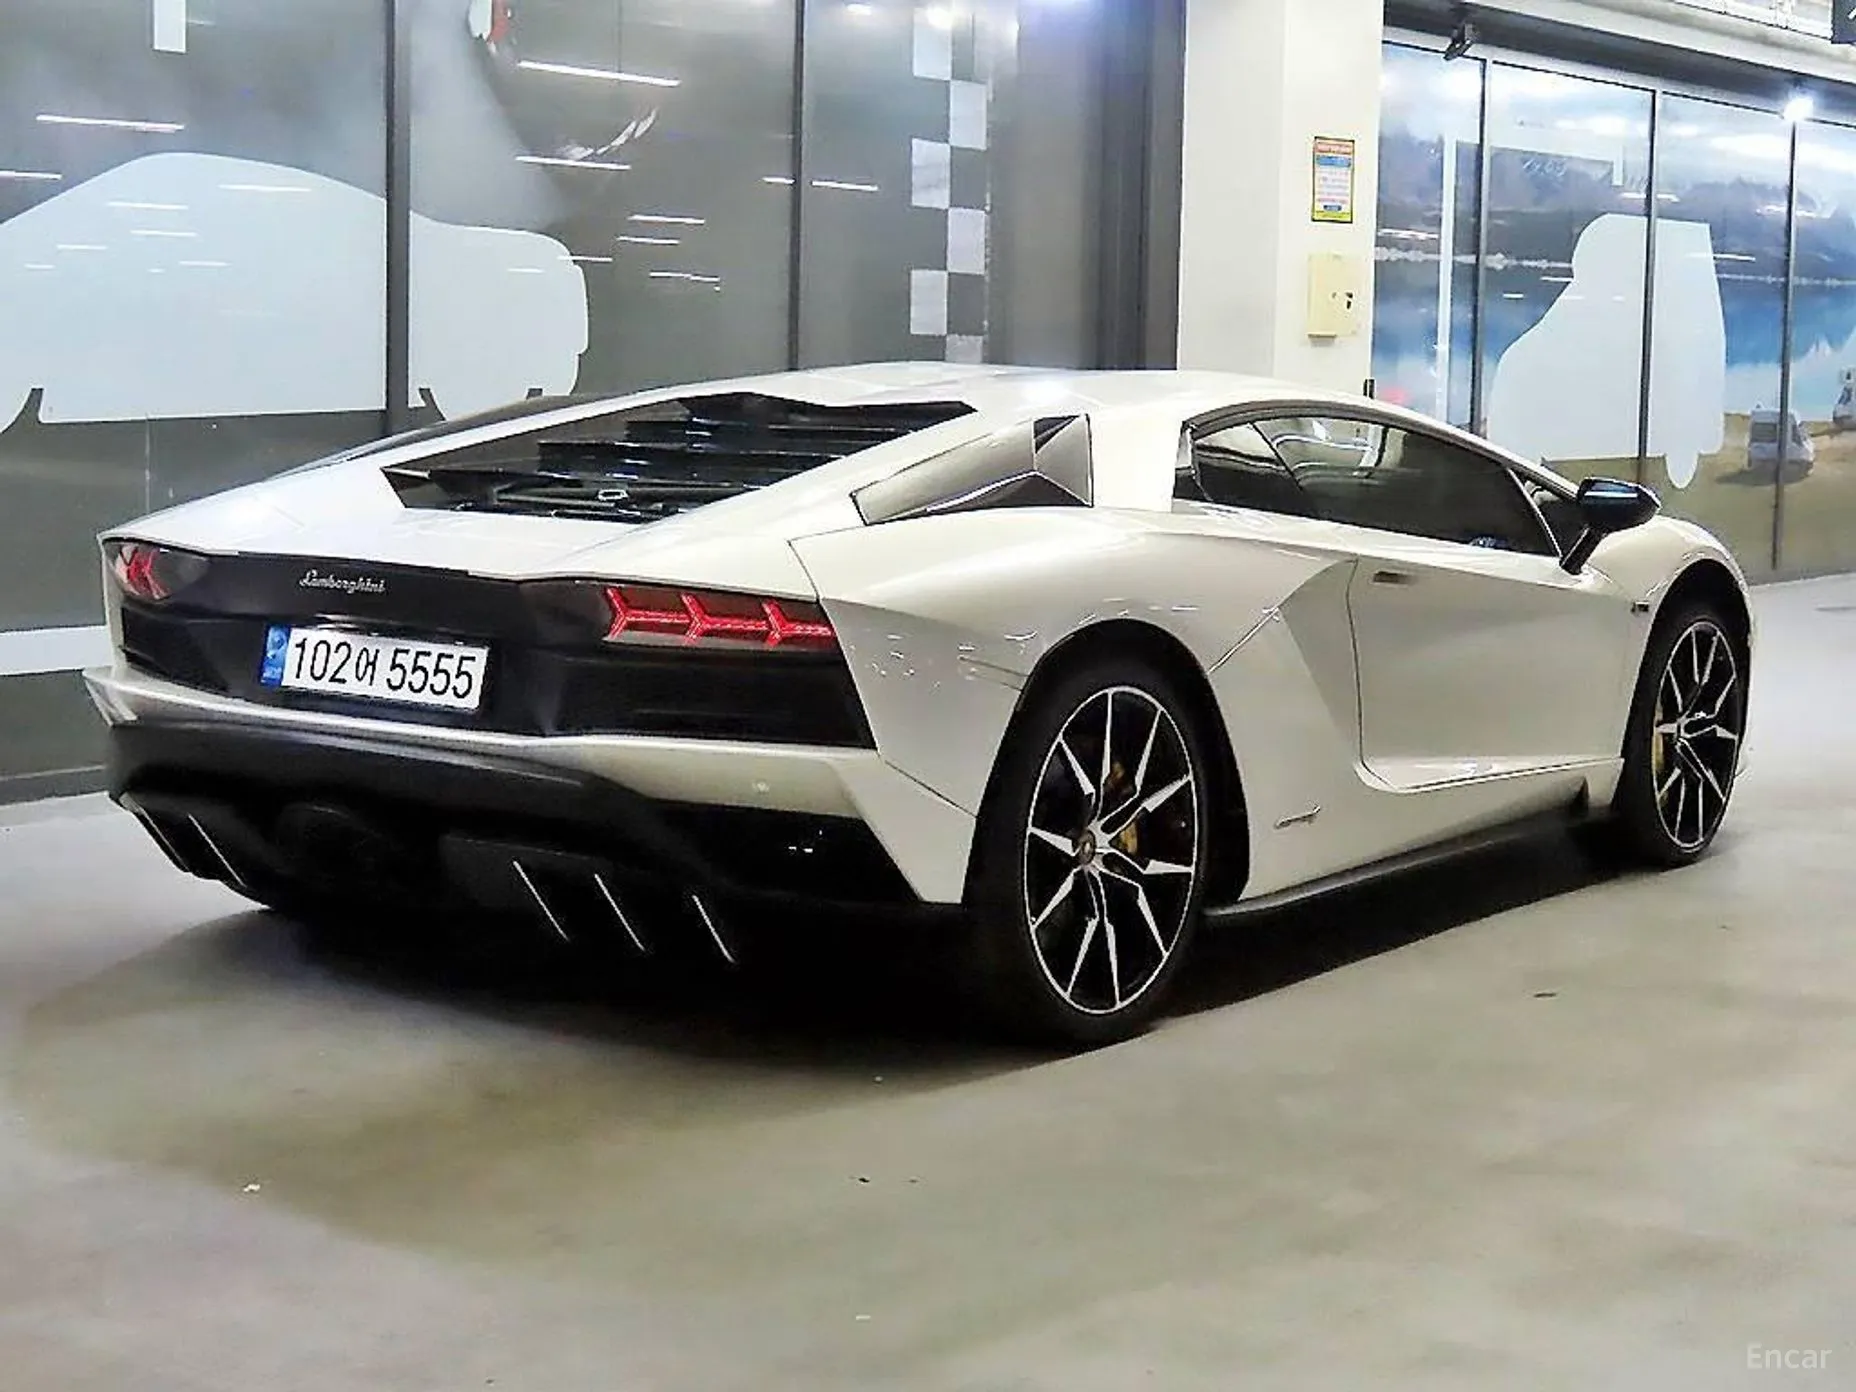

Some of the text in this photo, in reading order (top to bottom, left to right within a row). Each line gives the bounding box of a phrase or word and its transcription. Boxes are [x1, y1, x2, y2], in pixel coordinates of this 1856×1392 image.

[299, 569, 386, 594] Lamborghini
[295, 637, 477, 699] 102어 5555
